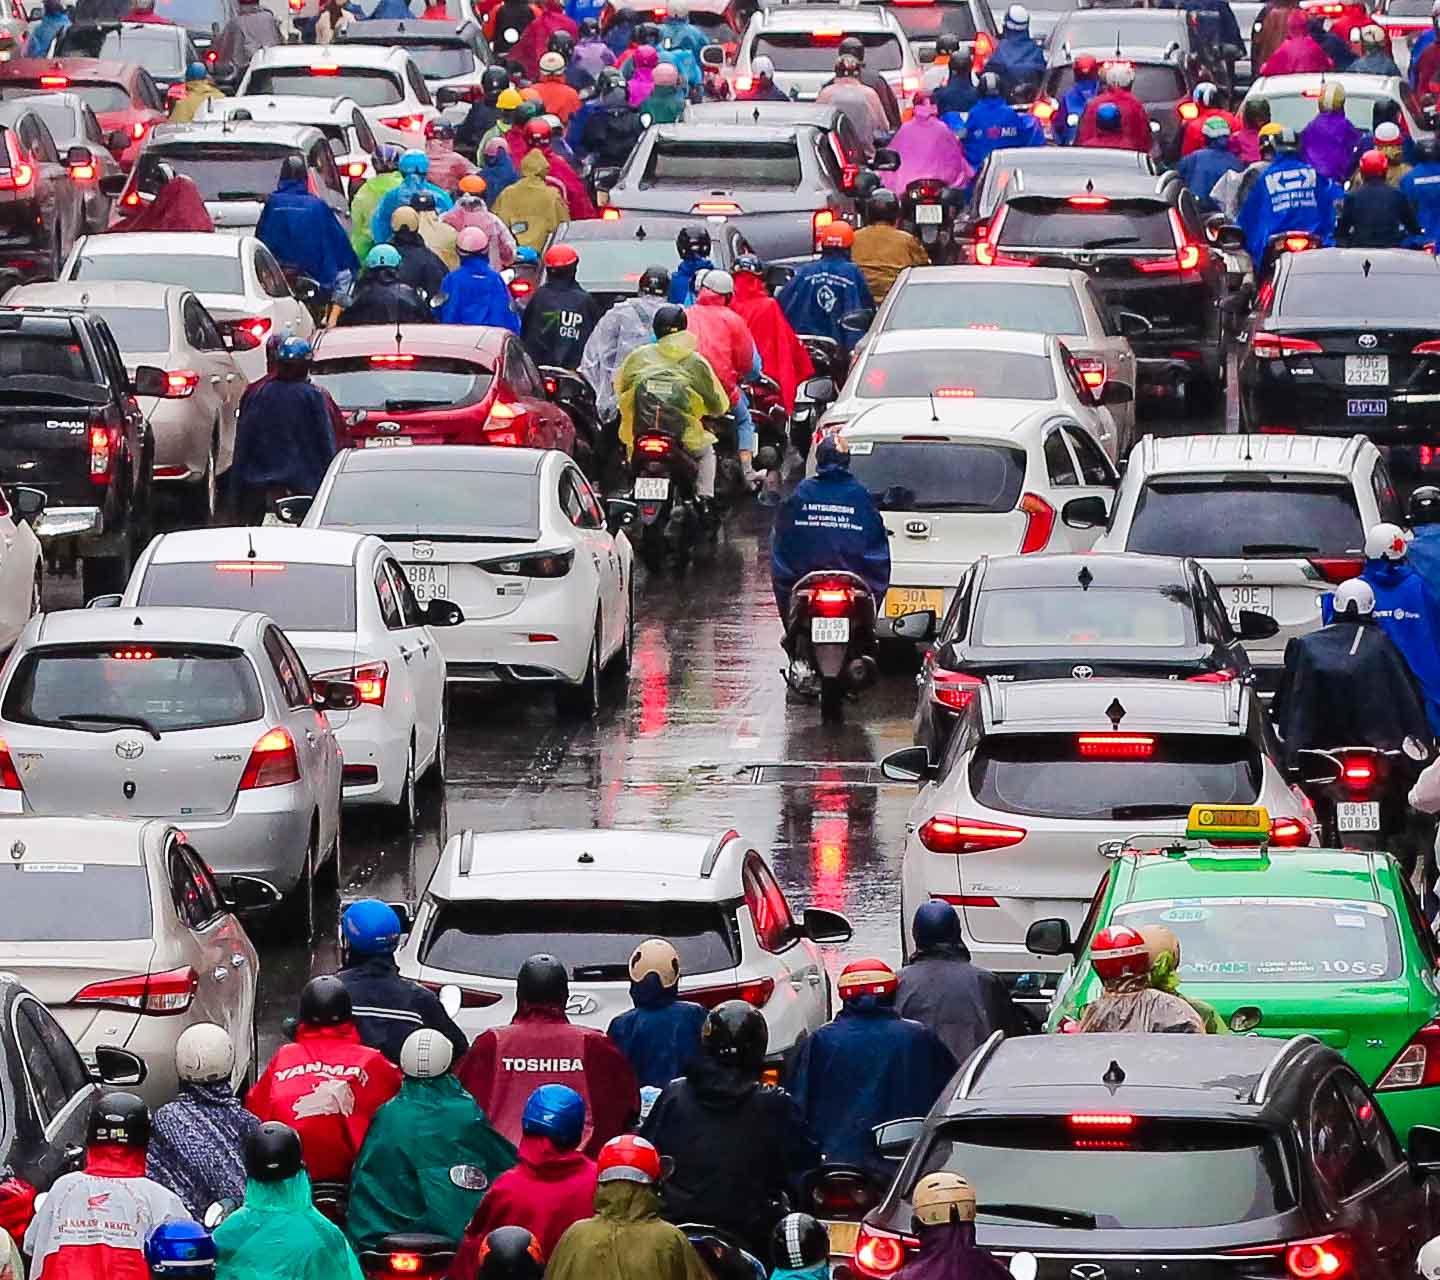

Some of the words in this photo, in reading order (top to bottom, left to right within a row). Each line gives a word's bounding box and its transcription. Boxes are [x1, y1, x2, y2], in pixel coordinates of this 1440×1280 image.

[561, 311, 583, 326] UP
[46, 420, 85, 430] D-MAX
[1320, 960, 1385, 976] 1055
[502, 1058, 584, 1073] TOSHIBA
